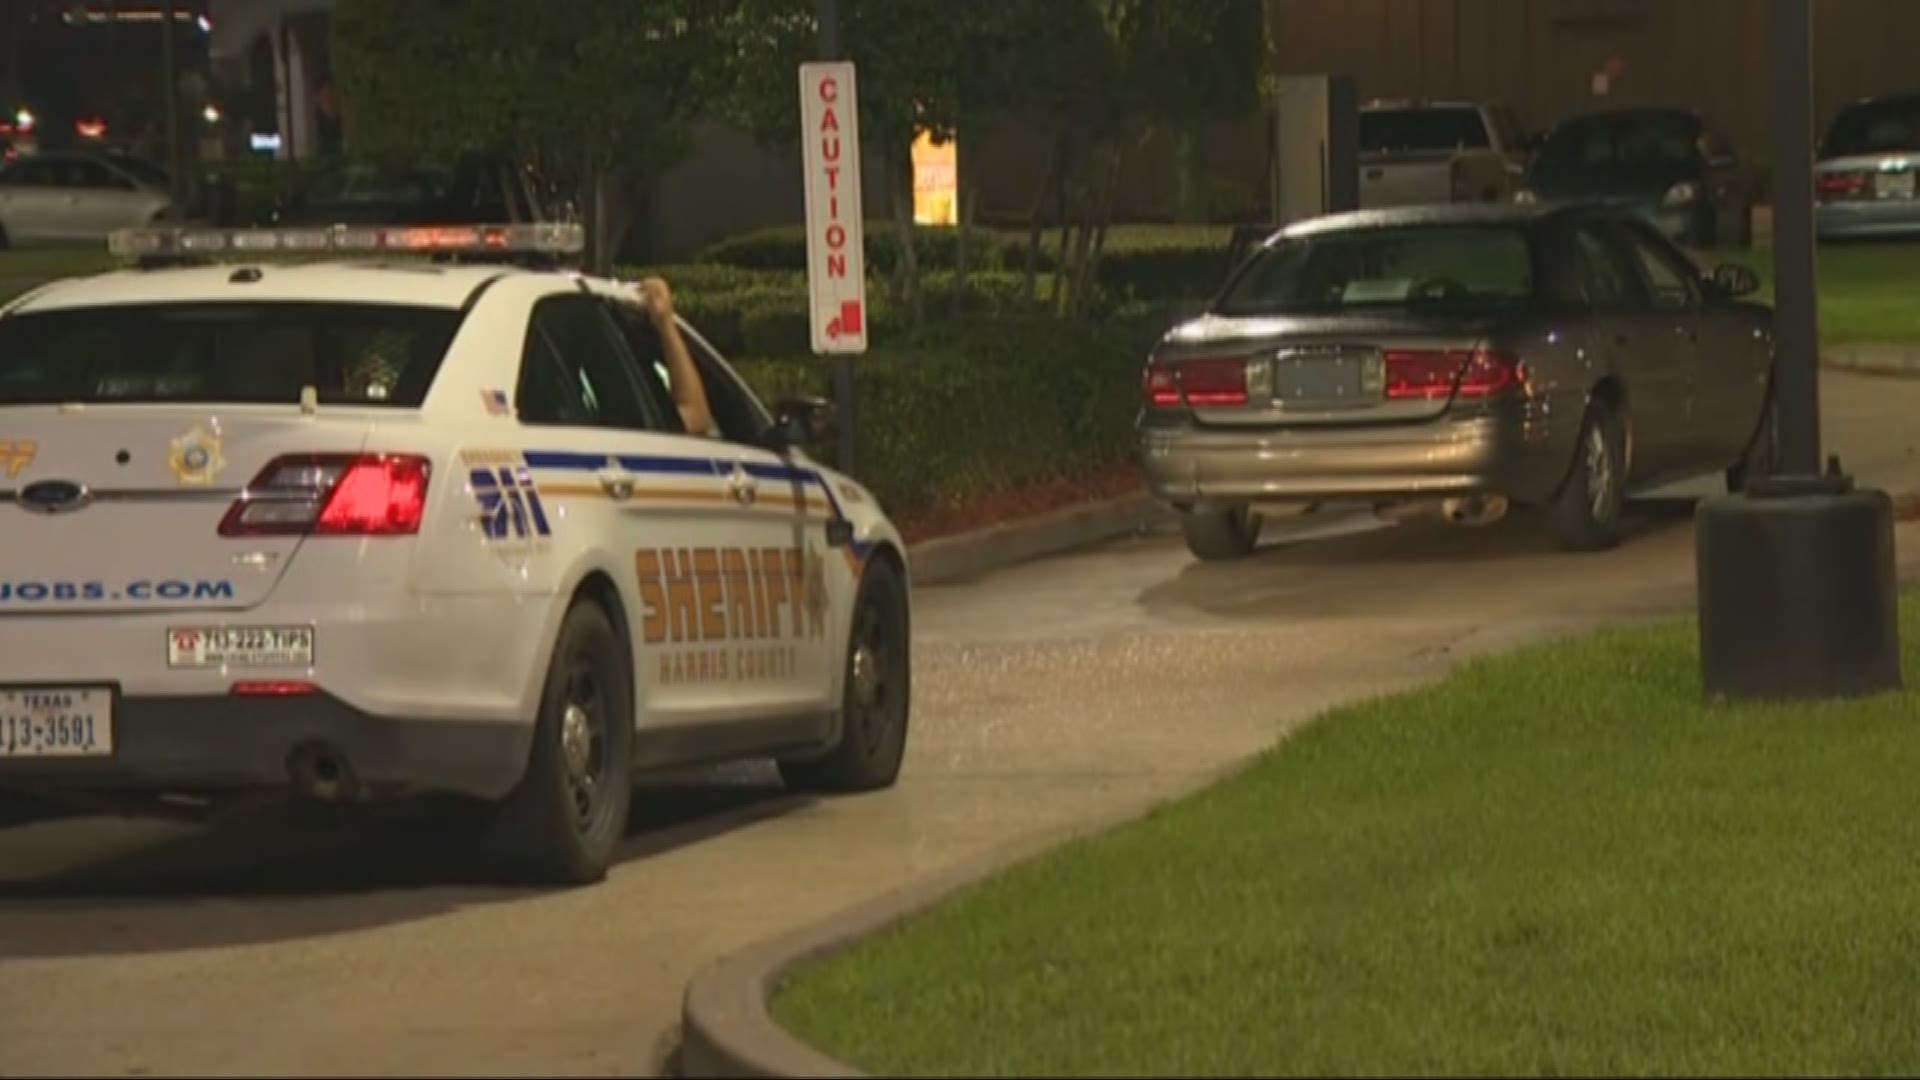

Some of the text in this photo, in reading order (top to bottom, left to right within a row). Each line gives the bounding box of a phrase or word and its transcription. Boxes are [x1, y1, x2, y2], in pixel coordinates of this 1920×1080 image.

[819, 78, 846, 278] CAUTION
[659, 647, 796, 685] HARRIS COUNTY
[23, 694, 72, 708] TEXAS
